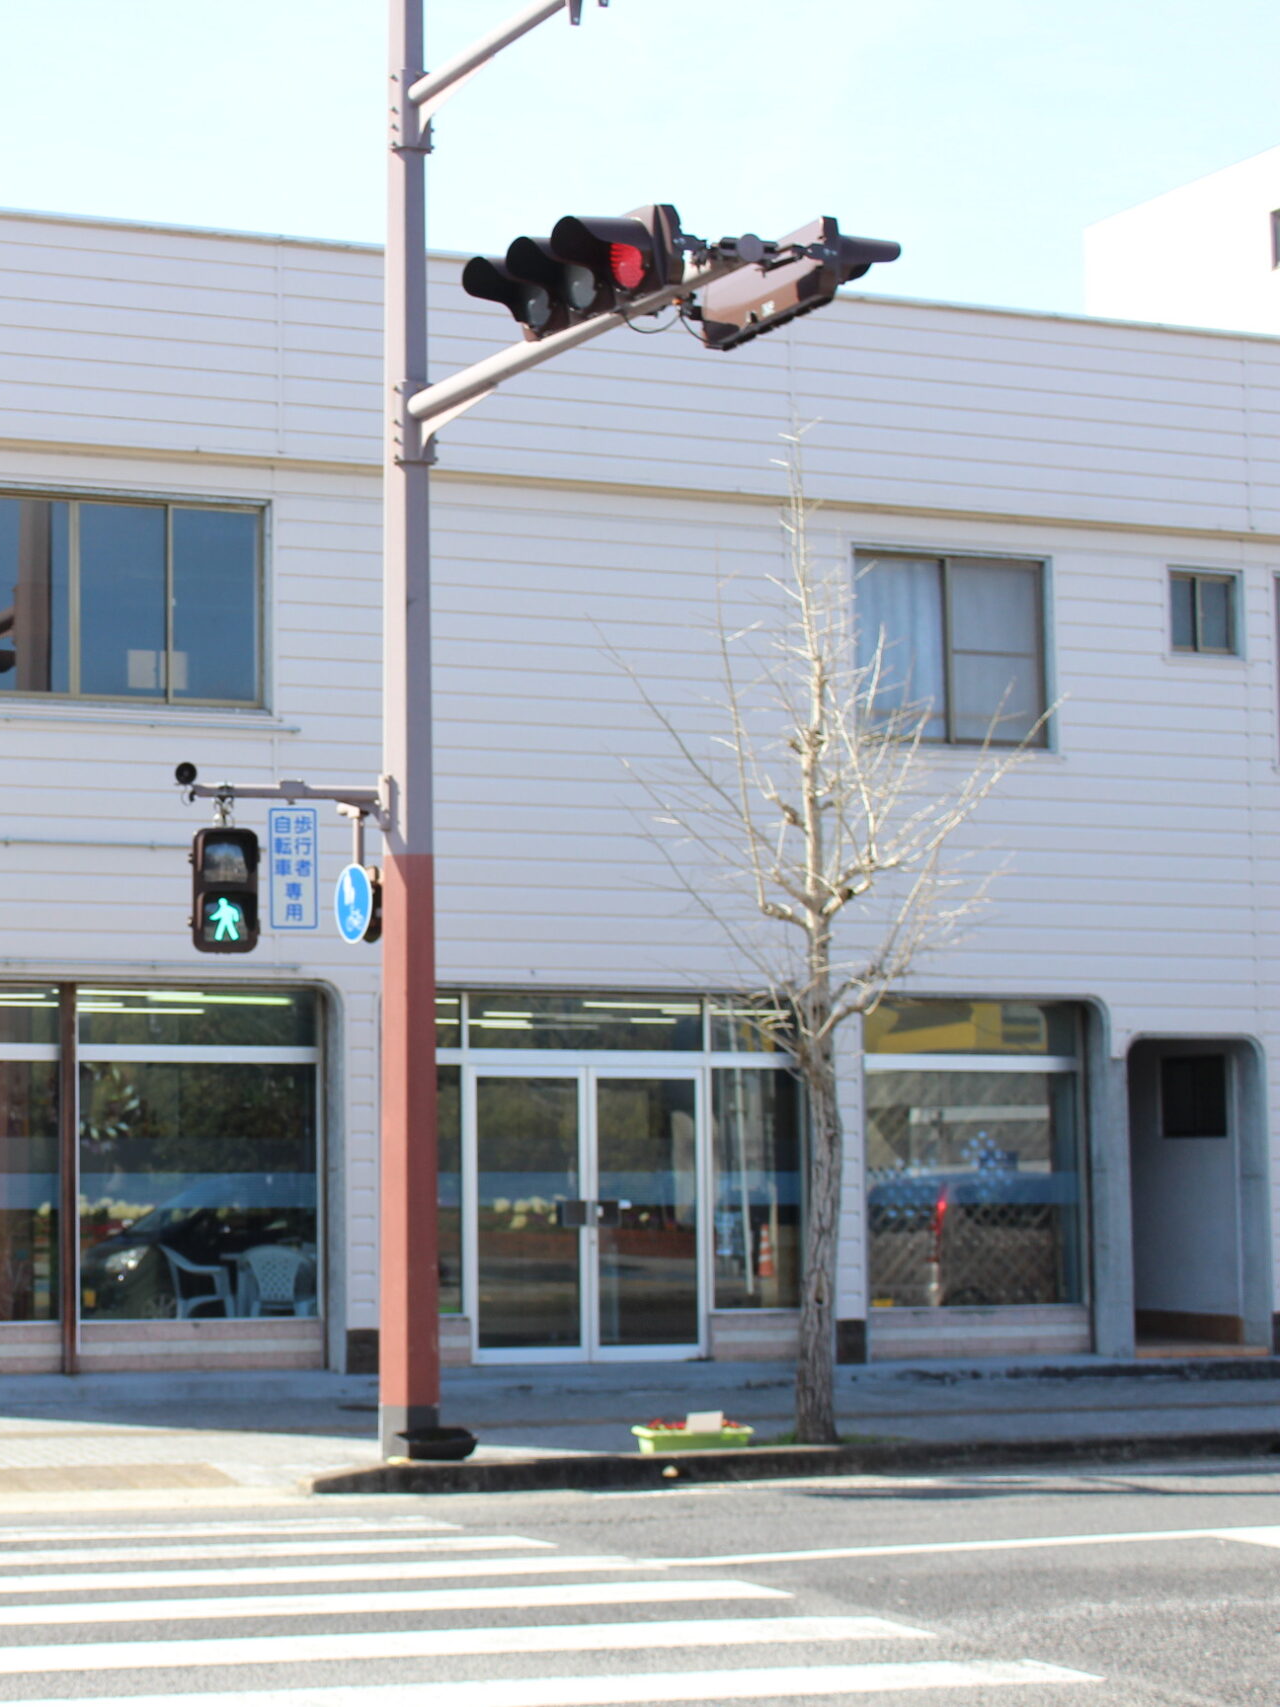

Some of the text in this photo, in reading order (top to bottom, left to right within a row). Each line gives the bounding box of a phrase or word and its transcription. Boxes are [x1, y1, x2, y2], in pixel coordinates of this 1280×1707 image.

[274, 816, 292, 876] 自転車
[294, 816, 312, 877] 歩行者
[285, 882, 303, 921] 専用
